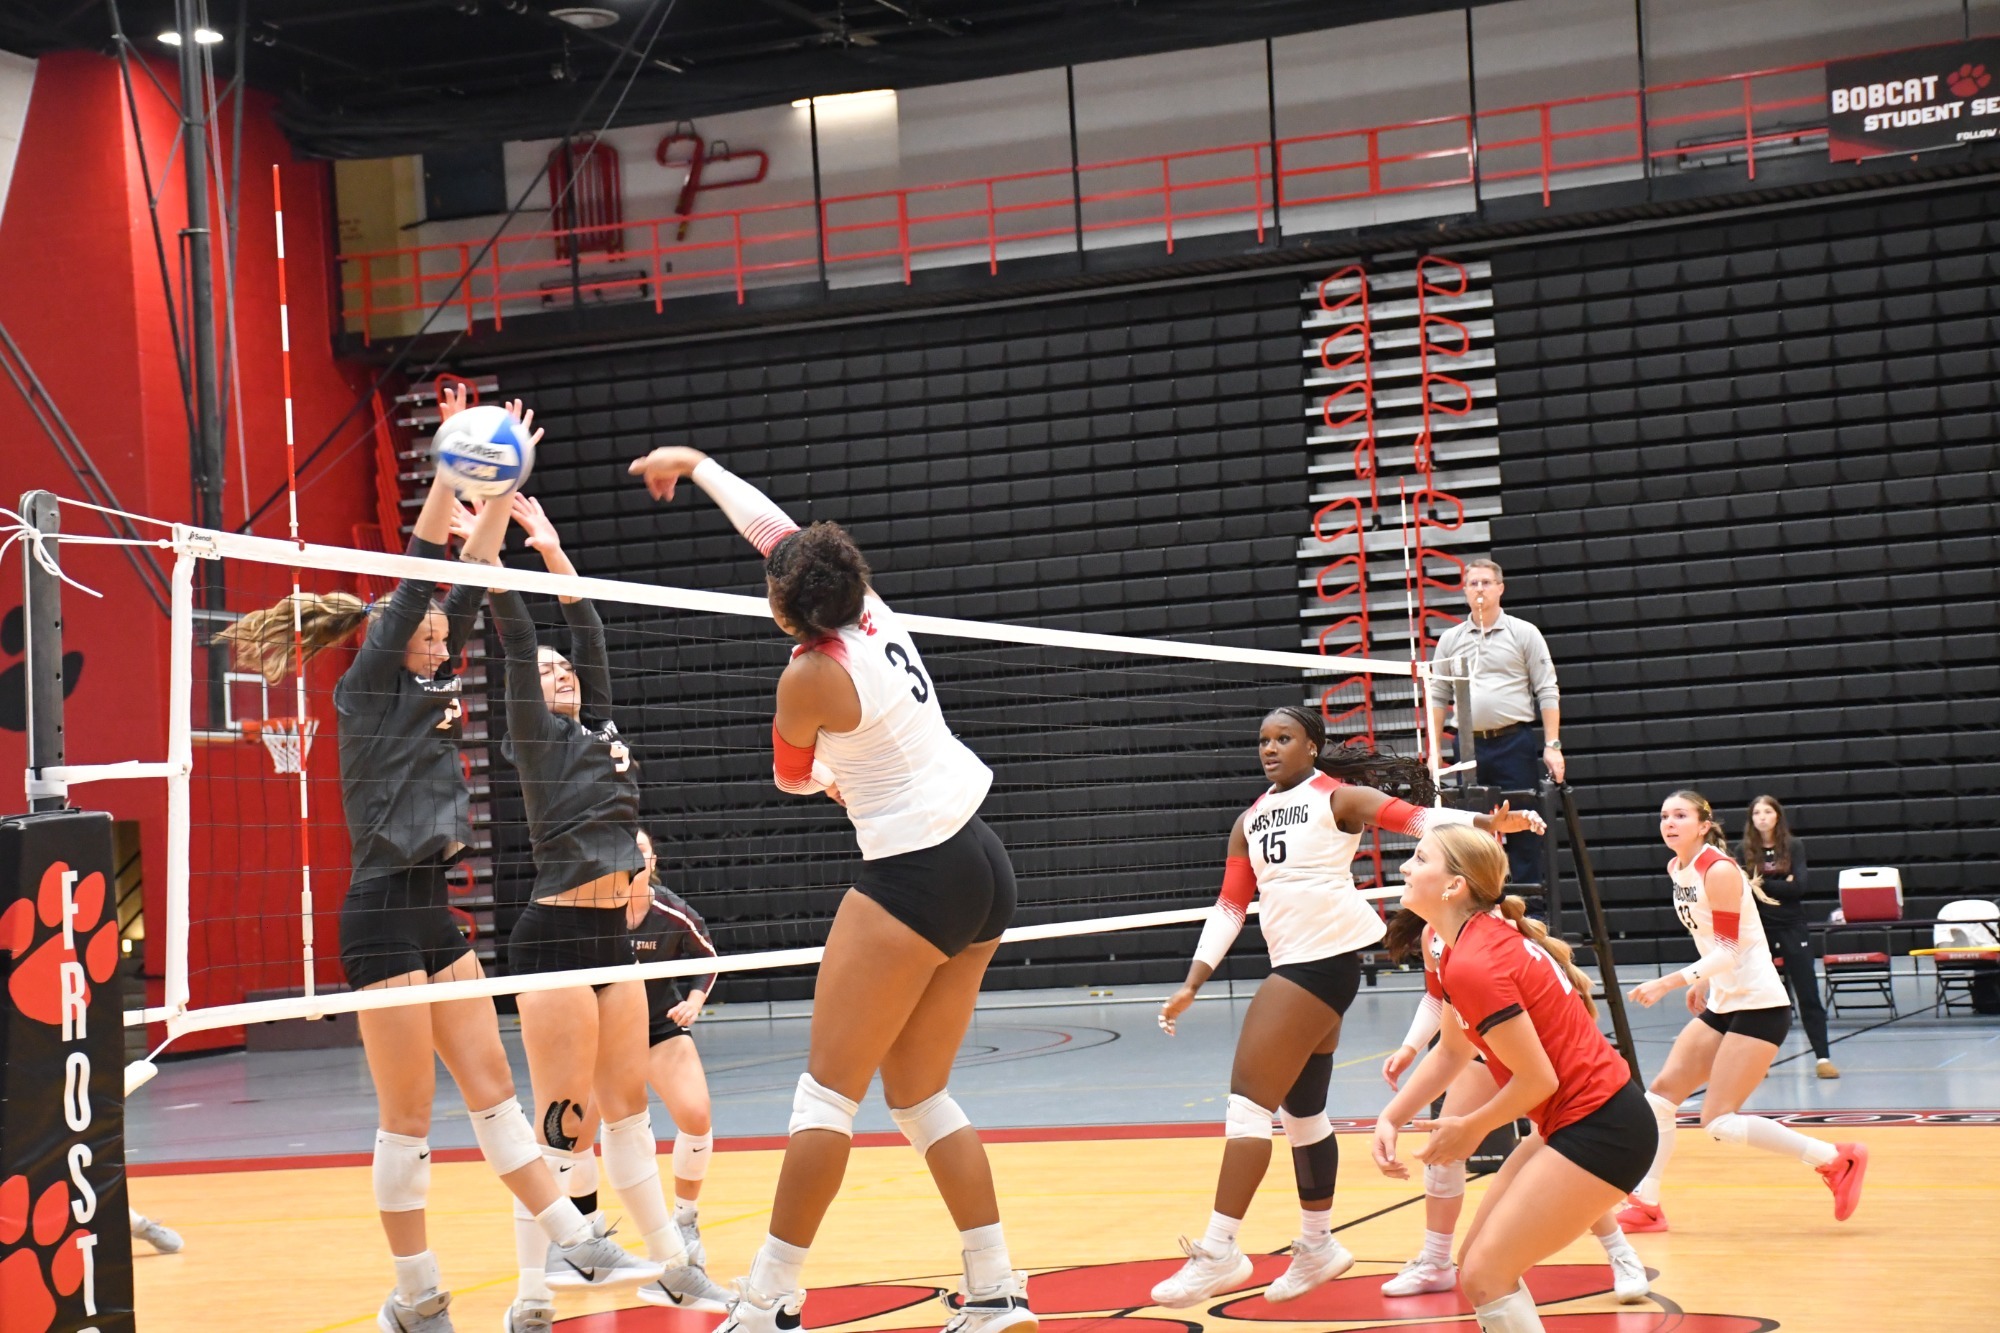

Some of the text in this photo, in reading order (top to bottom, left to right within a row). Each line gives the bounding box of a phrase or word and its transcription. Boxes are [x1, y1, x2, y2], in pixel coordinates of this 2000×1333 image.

[1832, 75, 1939, 114] BOBCAT
[1864, 101, 1965, 132] STUDENT
[1956, 128, 1998, 141] FOLLOW
[885, 641, 928, 704] 3
[1259, 830, 1287, 864] 15
[636, 940, 657, 950] STATE
[60, 870, 101, 1333] FROST
